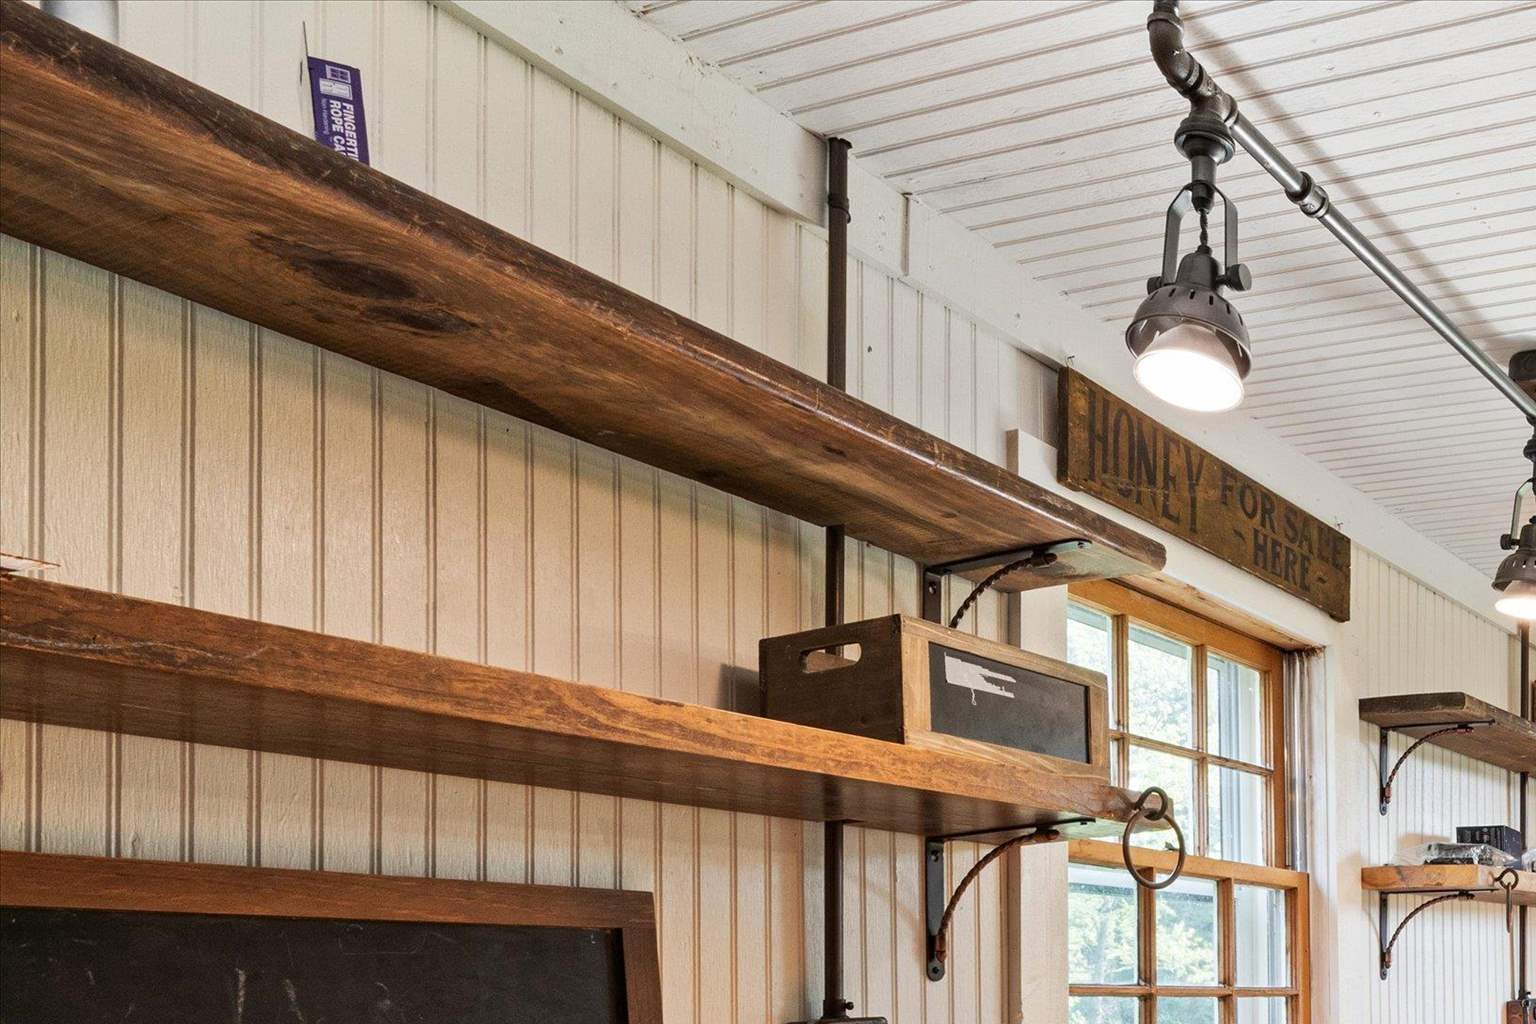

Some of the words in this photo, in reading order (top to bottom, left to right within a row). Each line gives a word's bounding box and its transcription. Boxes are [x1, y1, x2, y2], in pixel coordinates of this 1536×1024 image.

[329, 100, 344, 134] ROPE
[1088, 388, 1206, 533] HONEY
[1221, 466, 1277, 535] FOR
[1253, 527, 1312, 593] HERE
